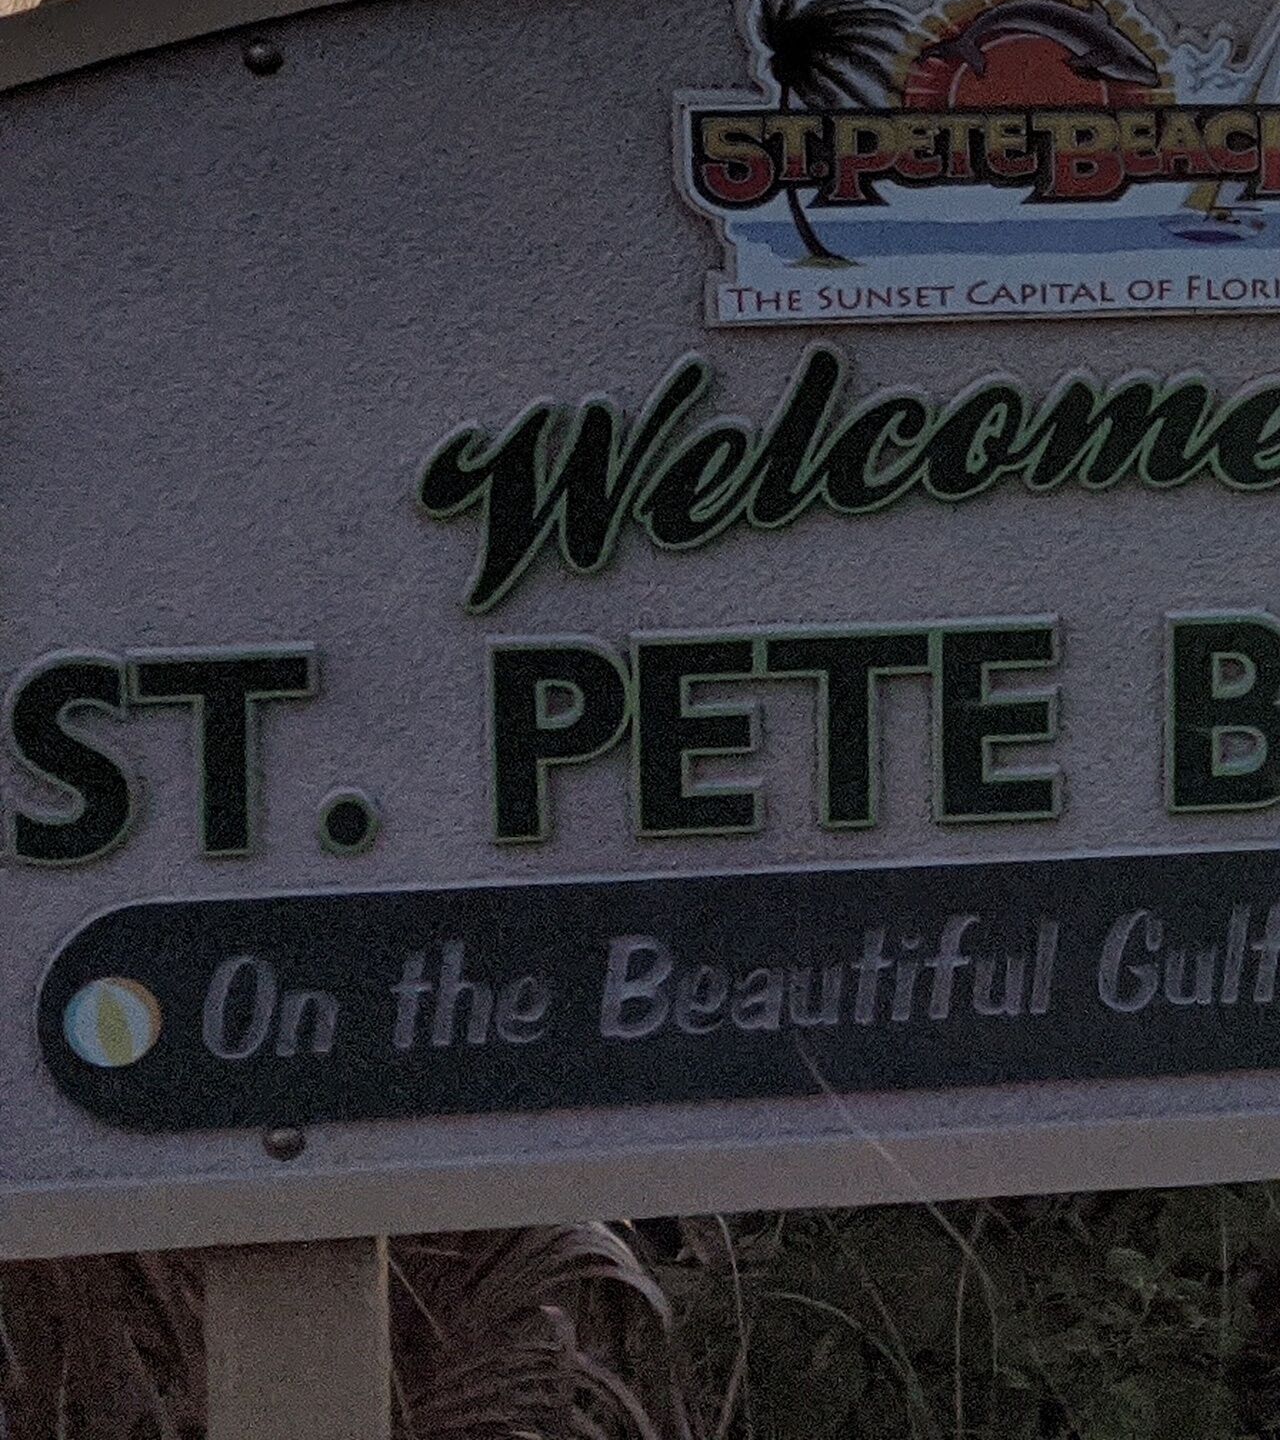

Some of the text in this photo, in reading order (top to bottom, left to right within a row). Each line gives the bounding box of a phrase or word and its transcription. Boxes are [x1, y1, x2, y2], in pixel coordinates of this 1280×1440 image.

[698, 109, 828, 209] ST.
[822, 109, 1042, 207] PETE
[728, 286, 802, 314] THE
[817, 284, 956, 311] SUNSET
[966, 280, 1115, 307] CAPITAL
[1128, 277, 1172, 302] OF
[5, 640, 384, 866] ST.
[485, 614, 1062, 844] PETE
[202, 954, 341, 1060] On
[391, 934, 550, 1050] the
[599, 913, 1060, 1040] Beautiful
